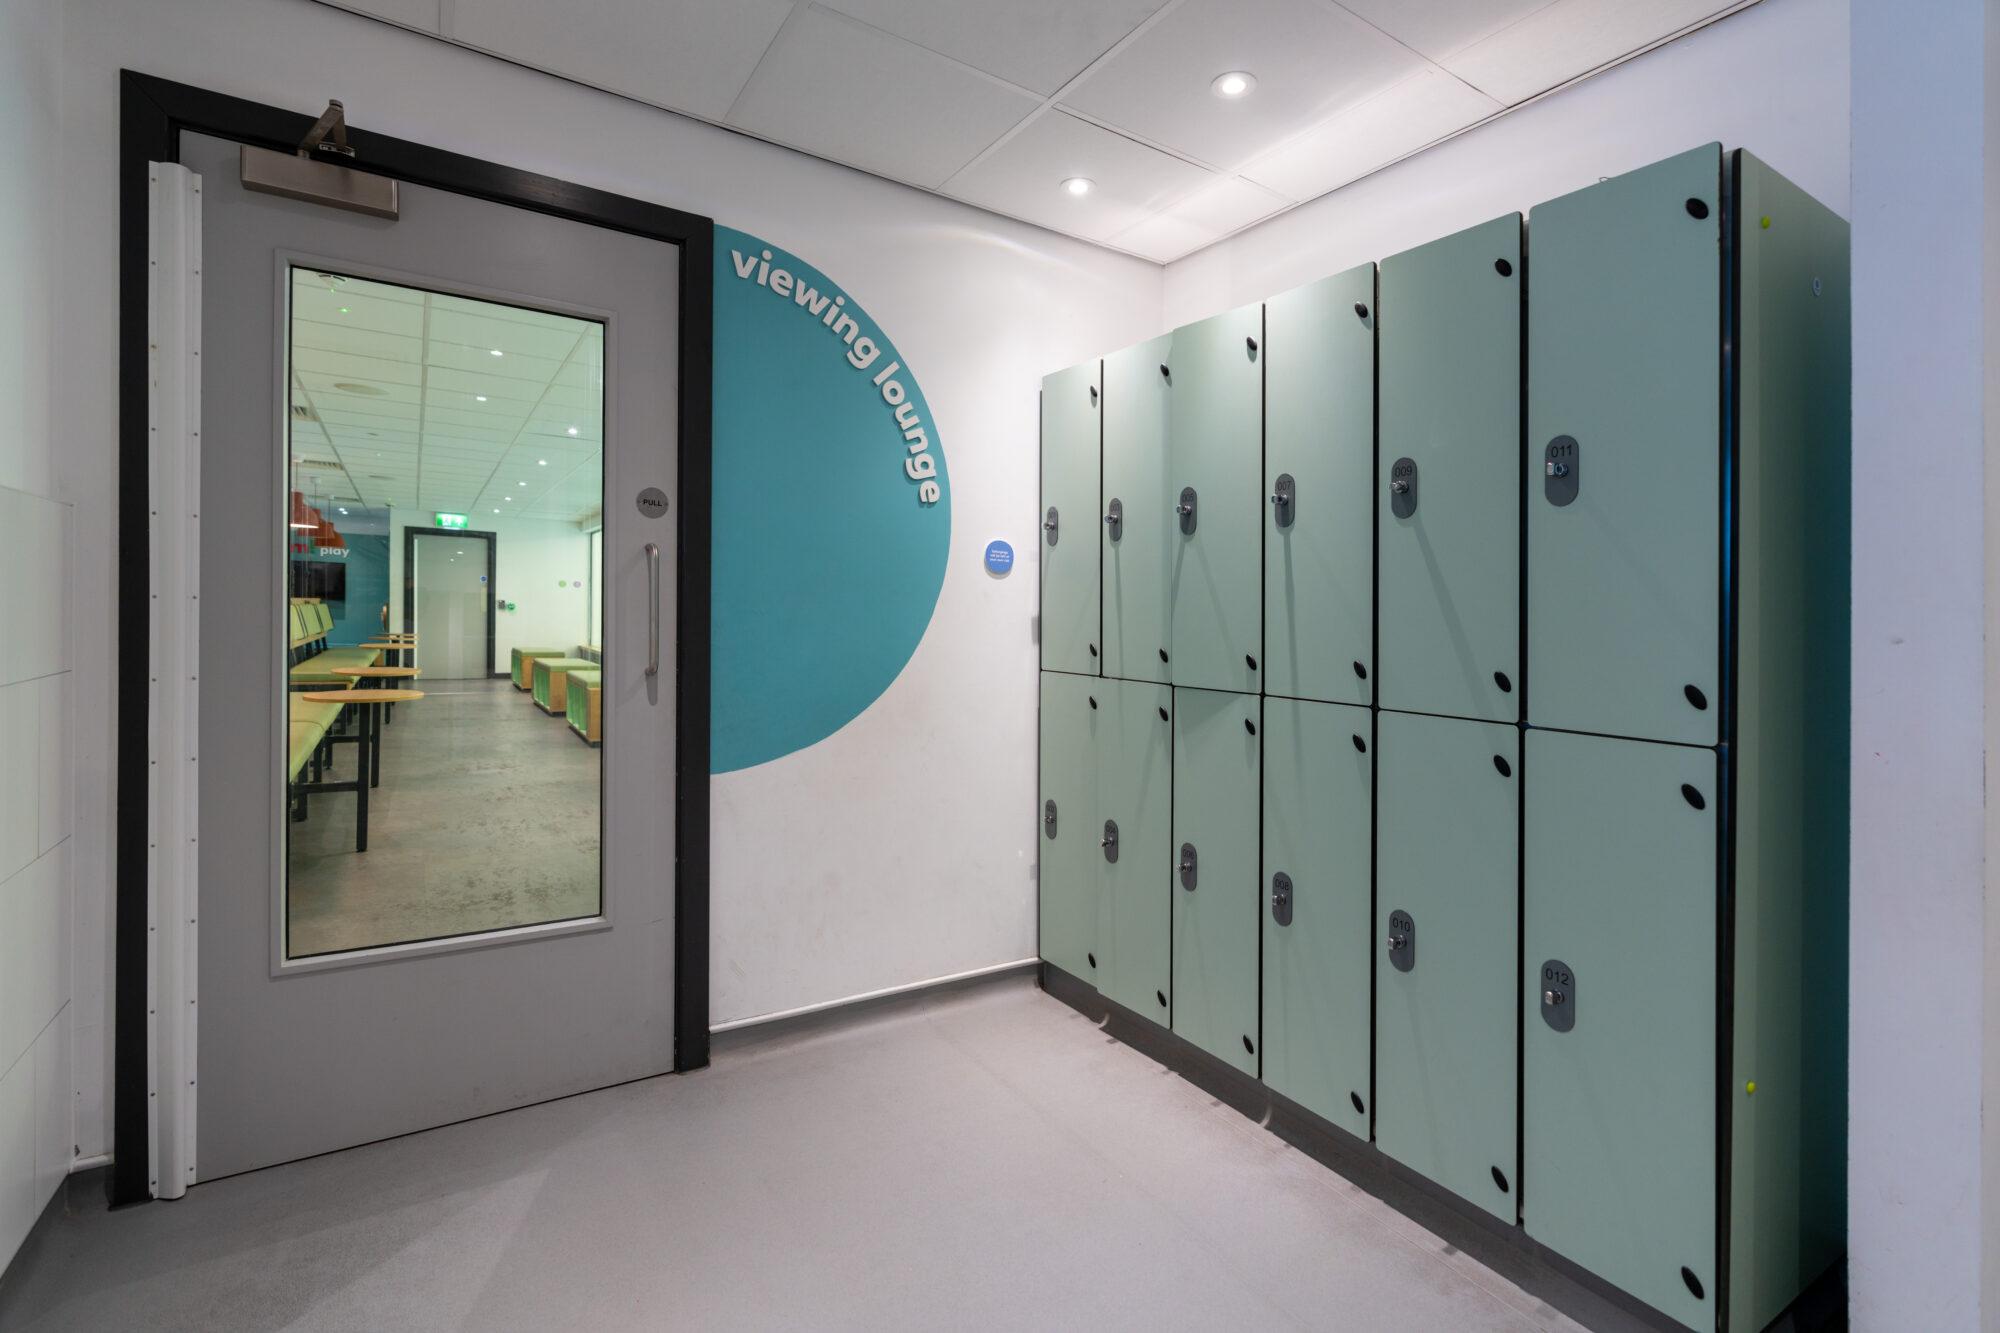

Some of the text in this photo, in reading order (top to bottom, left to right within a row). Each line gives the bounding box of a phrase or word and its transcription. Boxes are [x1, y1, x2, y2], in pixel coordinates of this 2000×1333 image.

[731, 249, 940, 503] viewing lounge
[1552, 444, 1572, 458] 011
[1395, 466, 1412, 478] 009
[1277, 480, 1291, 490] 007
[320, 547, 349, 558] play
[1275, 879, 1289, 891] 008
[1393, 917, 1410, 932] 010
[1546, 968, 1569, 986] 012
